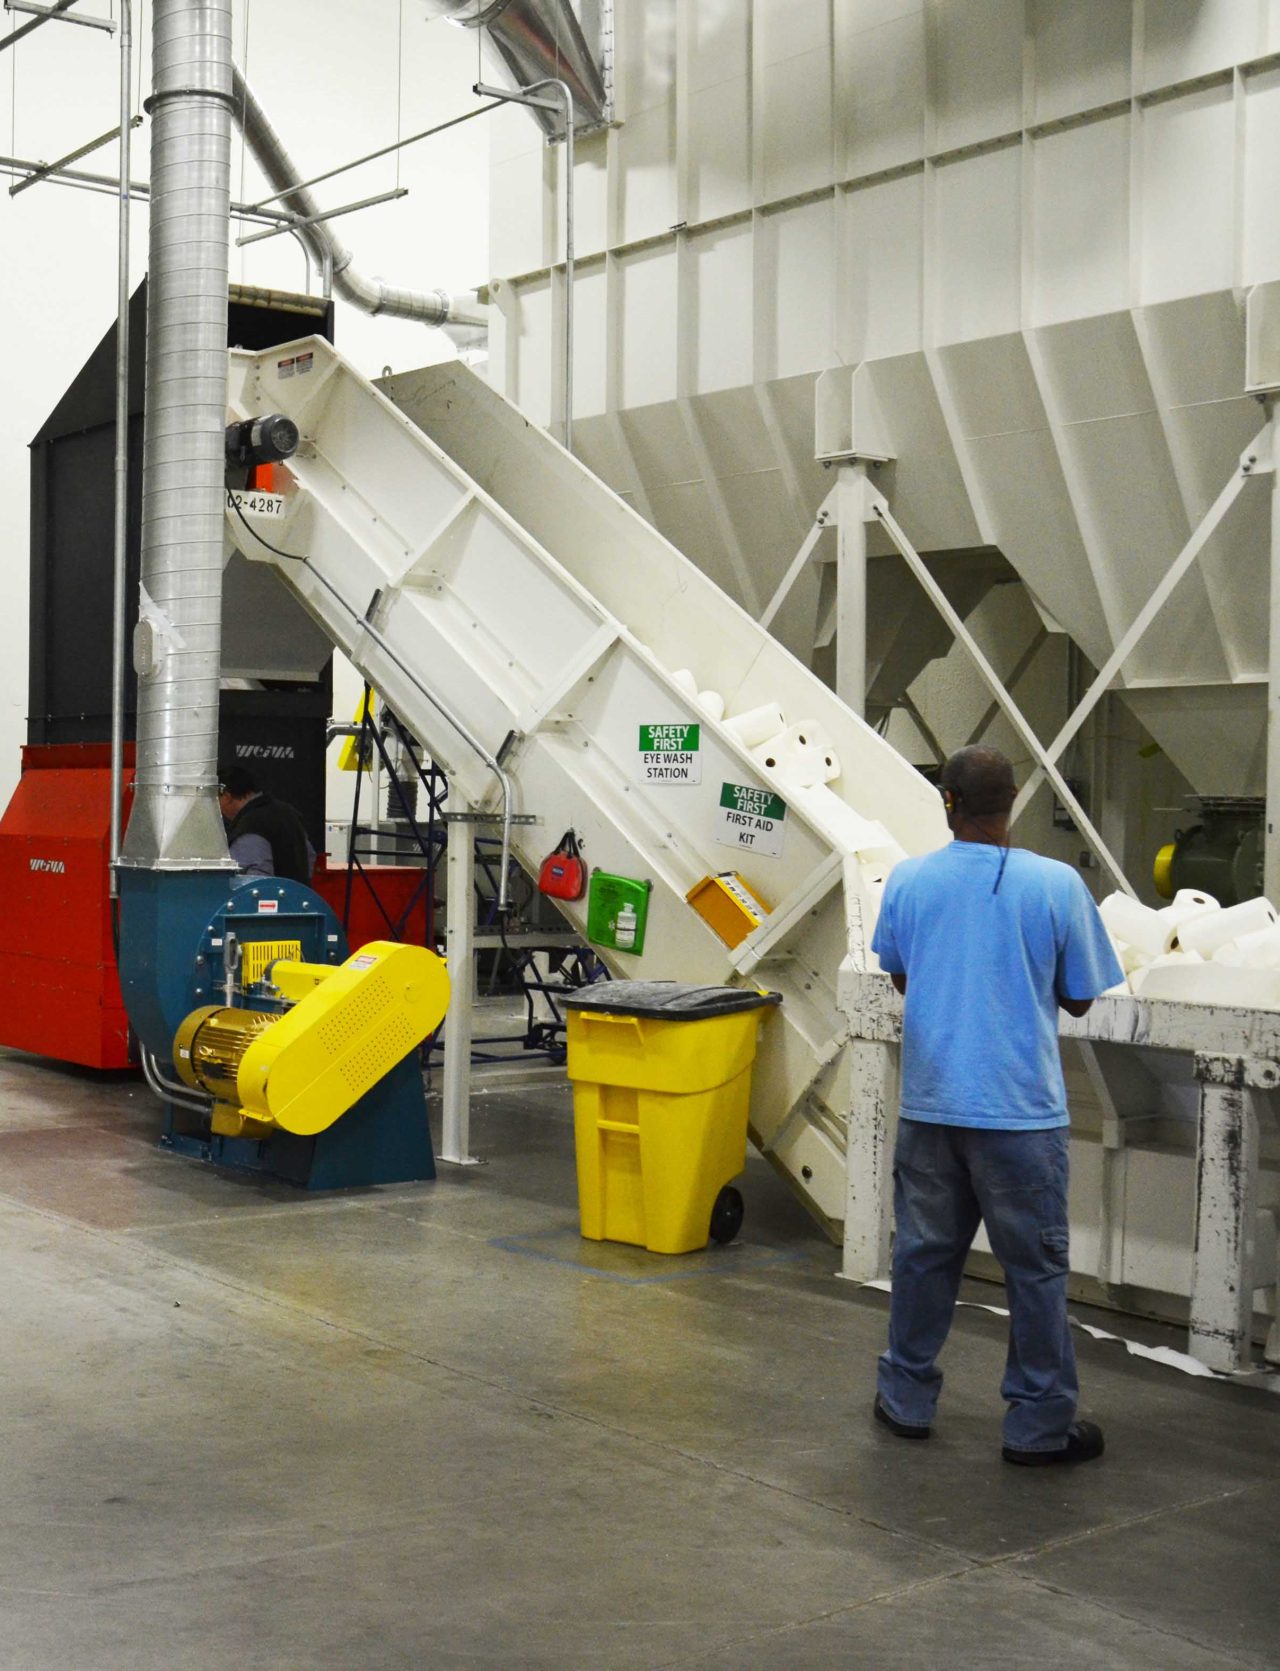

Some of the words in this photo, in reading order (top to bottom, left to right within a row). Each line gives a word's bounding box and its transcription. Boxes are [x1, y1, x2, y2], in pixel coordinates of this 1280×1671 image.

[648, 726, 690, 738] SAFETY
[653, 738, 684, 750] FIRST
[643, 753, 661, 764] EYE
[663, 753, 693, 764] WASH
[647, 767, 688, 778] STATION
[733, 786, 774, 805] SAFETY
[736, 798, 768, 815] FIRST
[726, 811, 754, 827] FIRST
[754, 818, 774, 832] AID
[738, 831, 756, 845] KIT
